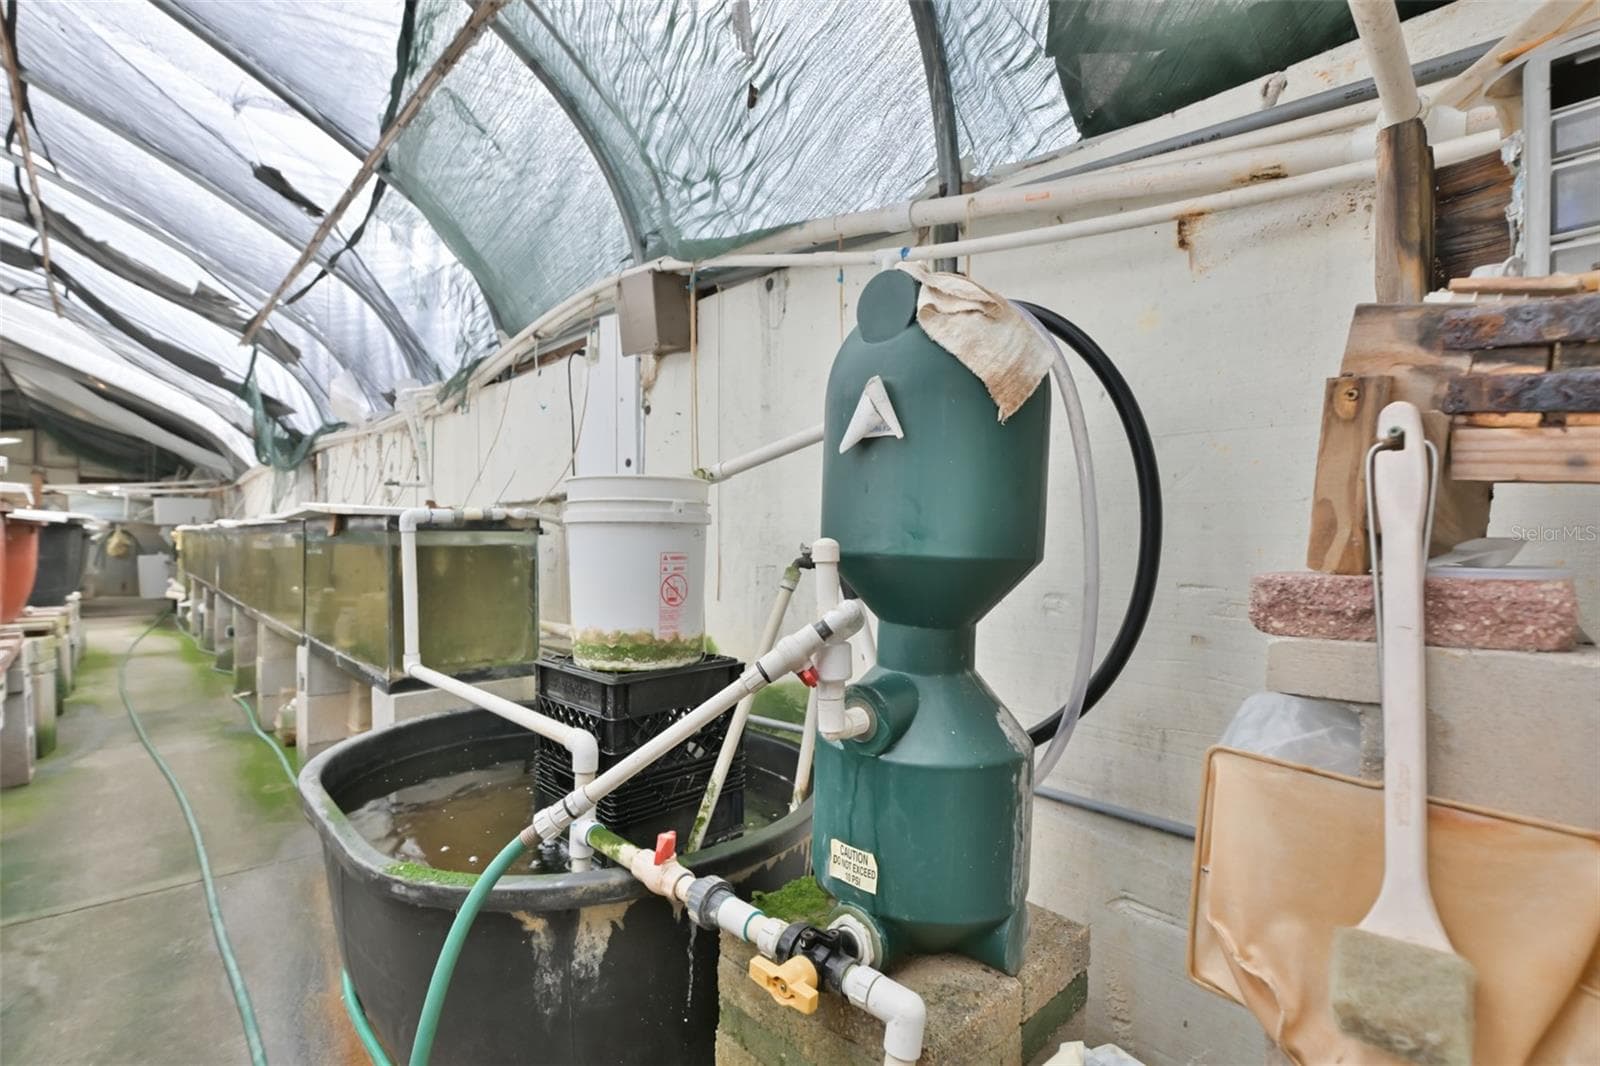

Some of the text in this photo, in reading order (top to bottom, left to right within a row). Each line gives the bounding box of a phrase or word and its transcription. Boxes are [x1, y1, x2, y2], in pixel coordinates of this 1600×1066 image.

[840, 844, 868, 866] CAUTION
[833, 854, 876, 880] DO NOT EXCEED
[852, 874, 861, 887] PSI
